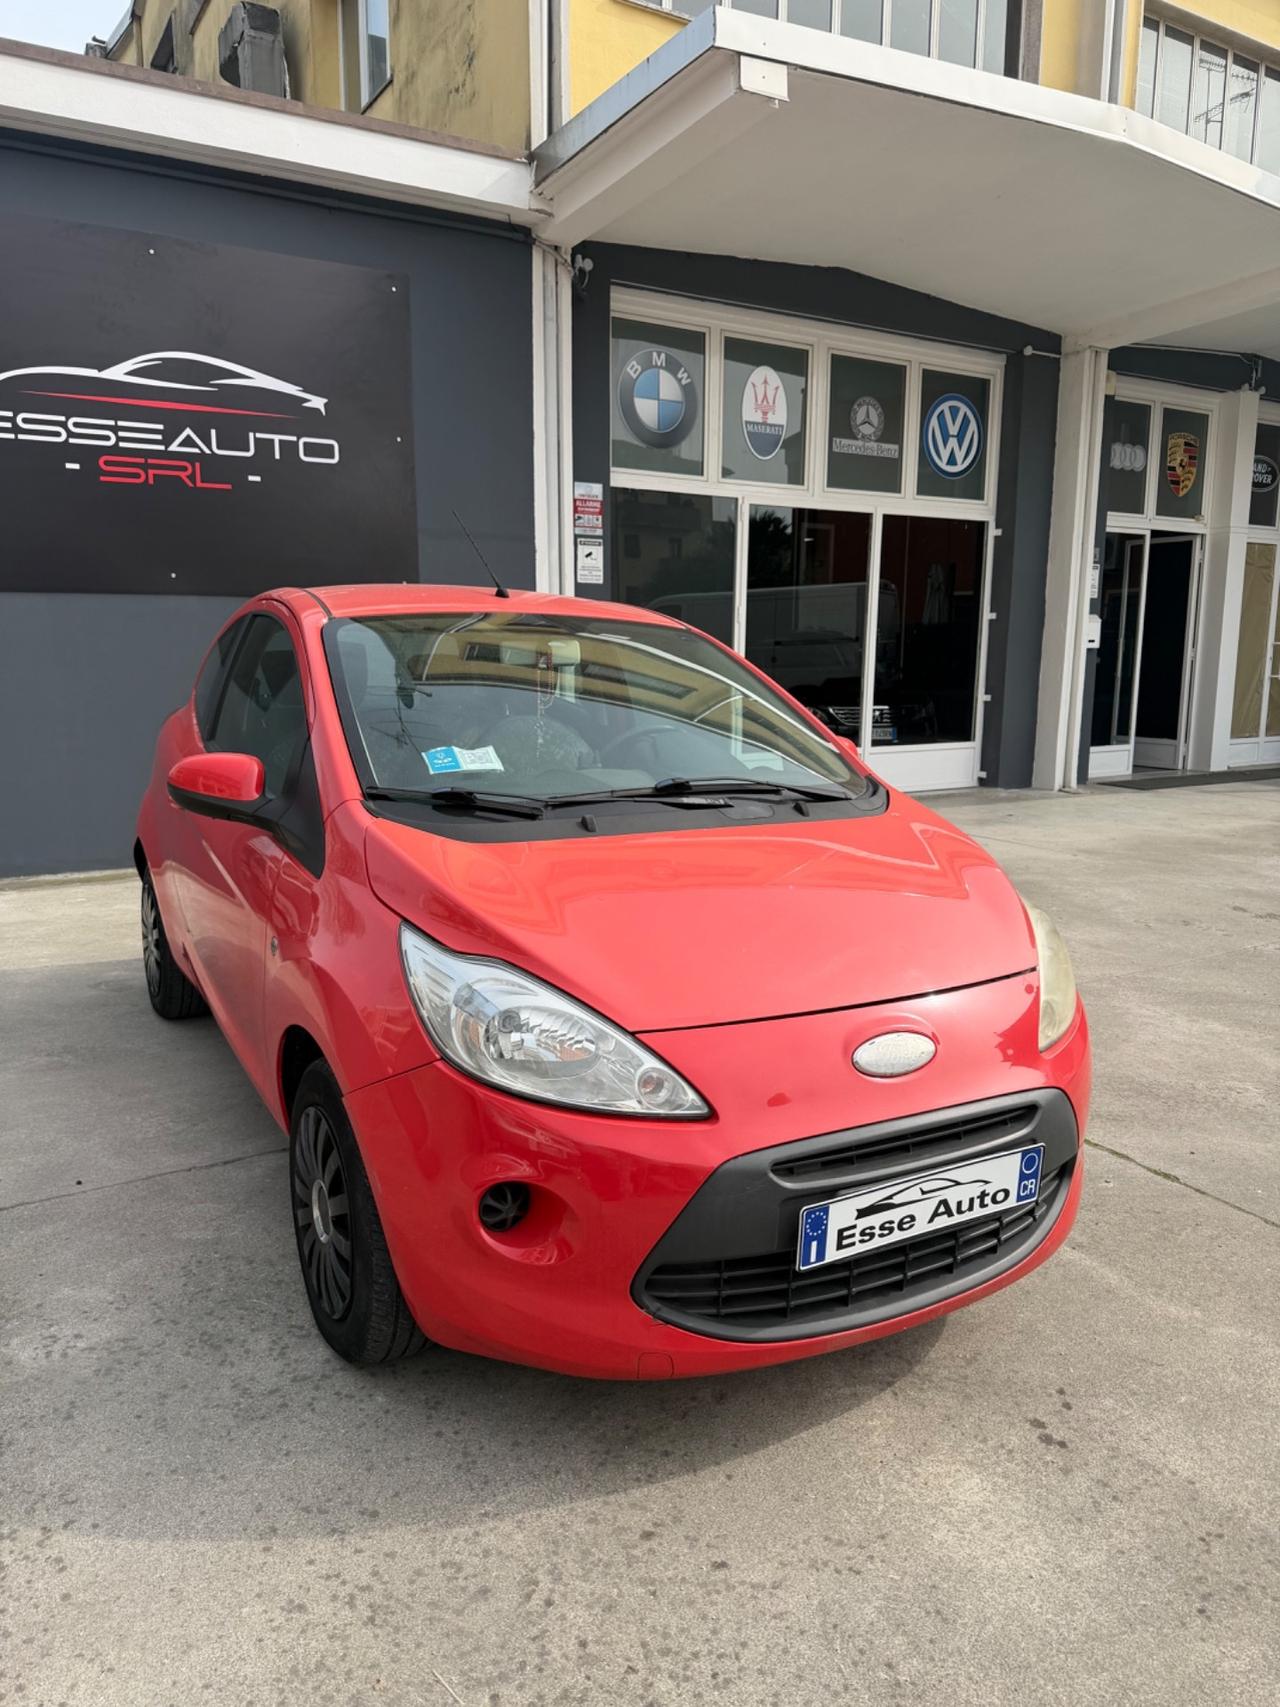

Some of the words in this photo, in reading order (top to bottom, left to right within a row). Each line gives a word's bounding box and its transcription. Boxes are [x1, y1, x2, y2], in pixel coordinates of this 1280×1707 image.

[626, 351, 692, 386] BMW
[746, 422, 783, 436] MASERATI
[832, 439, 899, 458] Mercedes-Benz
[98, 455, 233, 490] SRL
[836, 1213, 917, 1251] Esse
[927, 1187, 1010, 1224] Auto
[1020, 1178, 1035, 1196] CR
